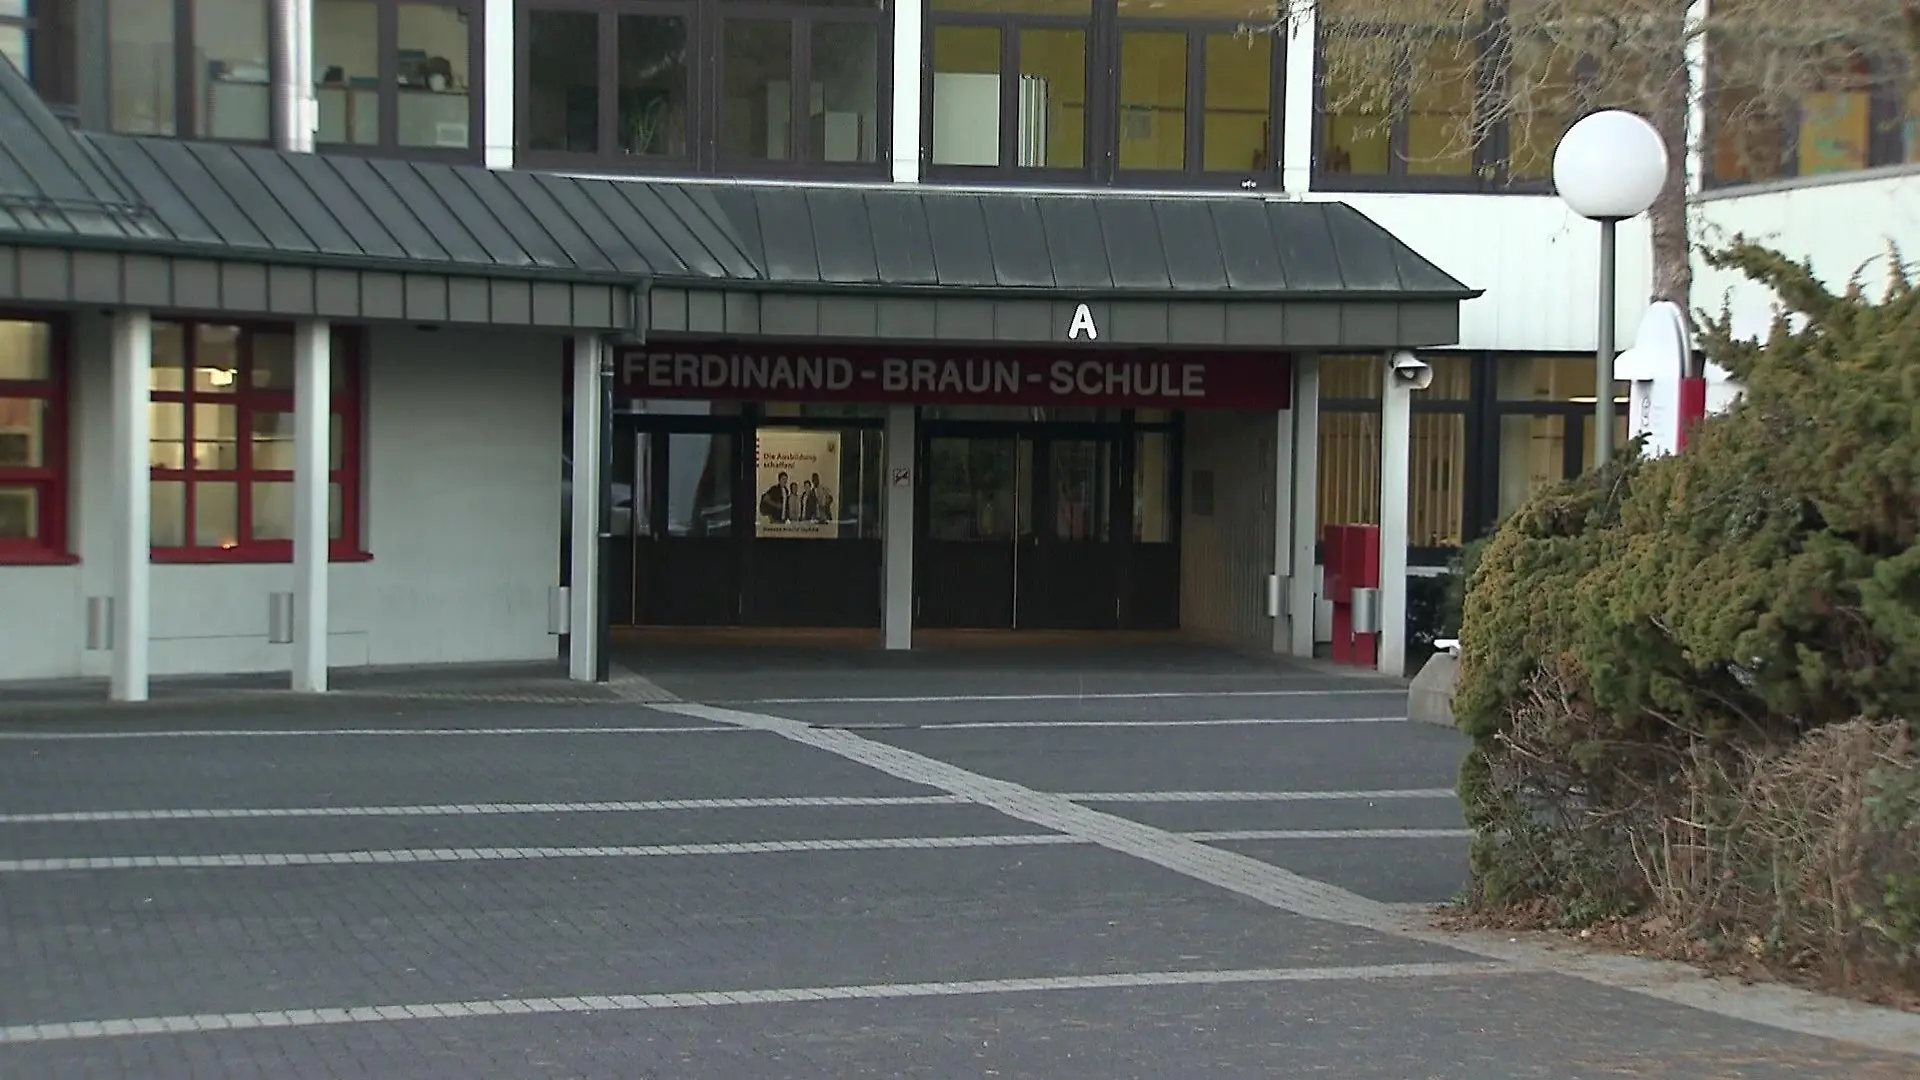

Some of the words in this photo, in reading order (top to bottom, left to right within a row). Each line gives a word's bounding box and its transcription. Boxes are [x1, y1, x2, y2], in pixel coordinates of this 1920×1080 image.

[1068, 303, 1098, 340] A
[763, 452, 775, 460] Die
[776, 452, 817, 463] Ausbildung
